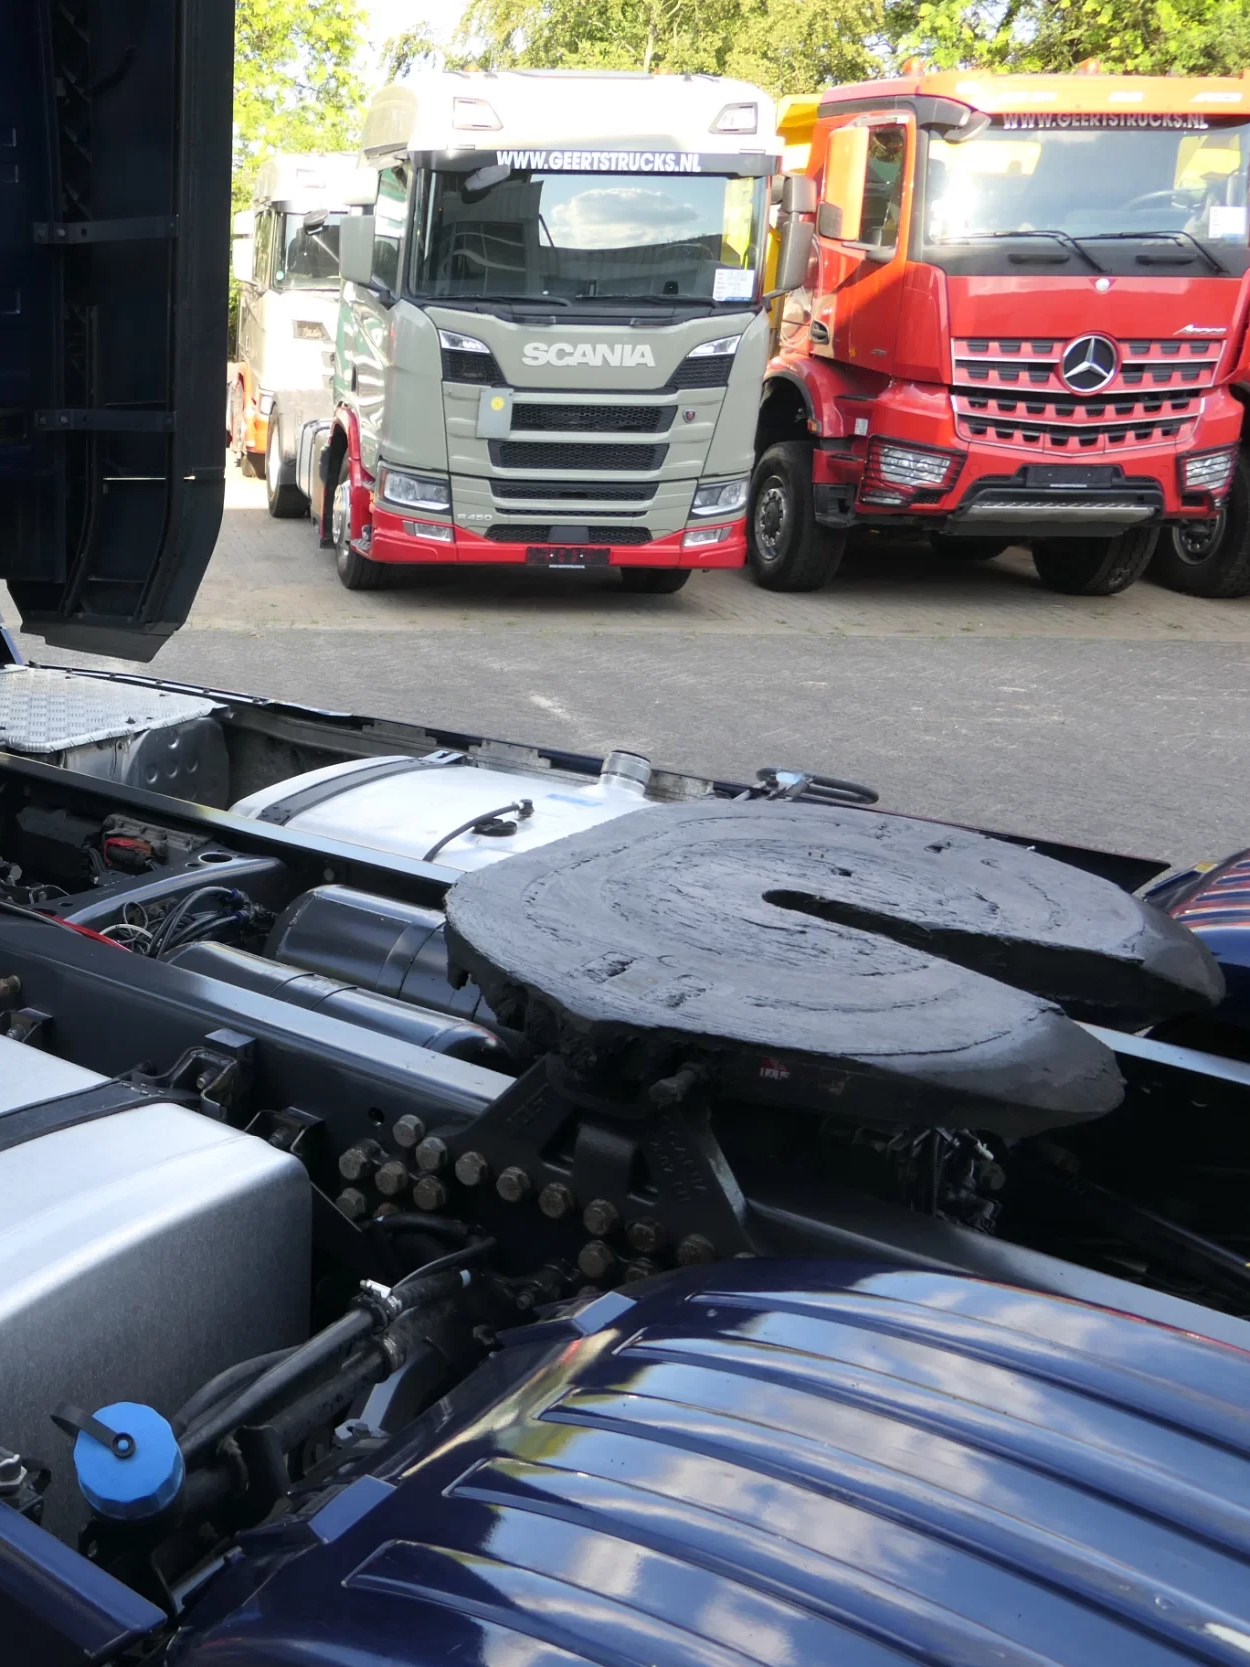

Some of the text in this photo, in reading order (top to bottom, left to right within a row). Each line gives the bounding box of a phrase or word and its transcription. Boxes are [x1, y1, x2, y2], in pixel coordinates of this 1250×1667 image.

[1003, 112, 1209, 129] WWW.GEERTSTRUCKS.NL
[496, 150, 701, 172] WWW.GEERTSTRUCKS.NL
[521, 342, 656, 367] SCANIA
